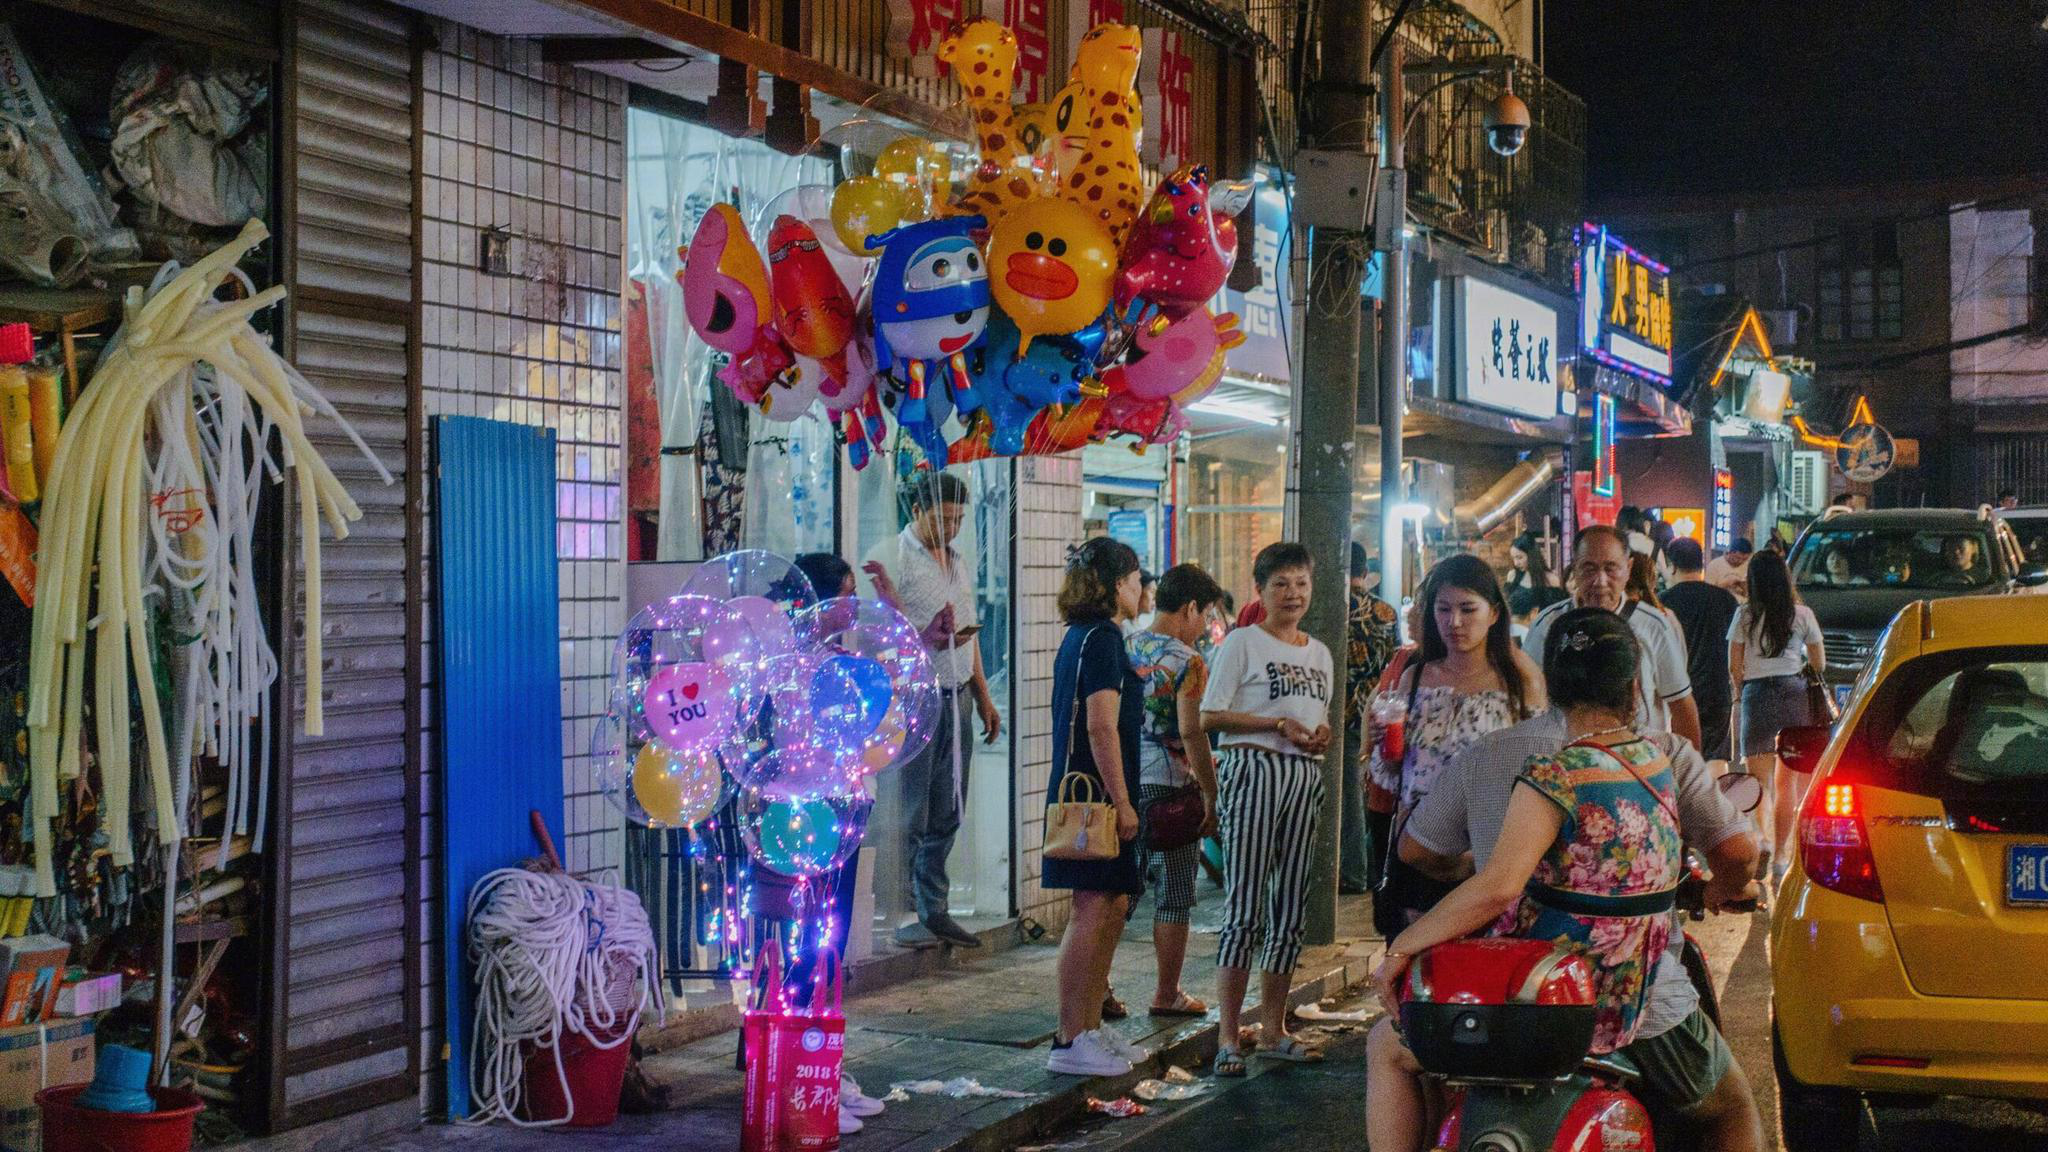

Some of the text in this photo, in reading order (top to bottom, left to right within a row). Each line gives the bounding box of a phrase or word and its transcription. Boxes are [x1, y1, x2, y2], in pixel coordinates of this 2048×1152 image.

[668, 689, 677, 706] I
[668, 702, 706, 726] YOU
[796, 1064, 831, 1079] 2018
